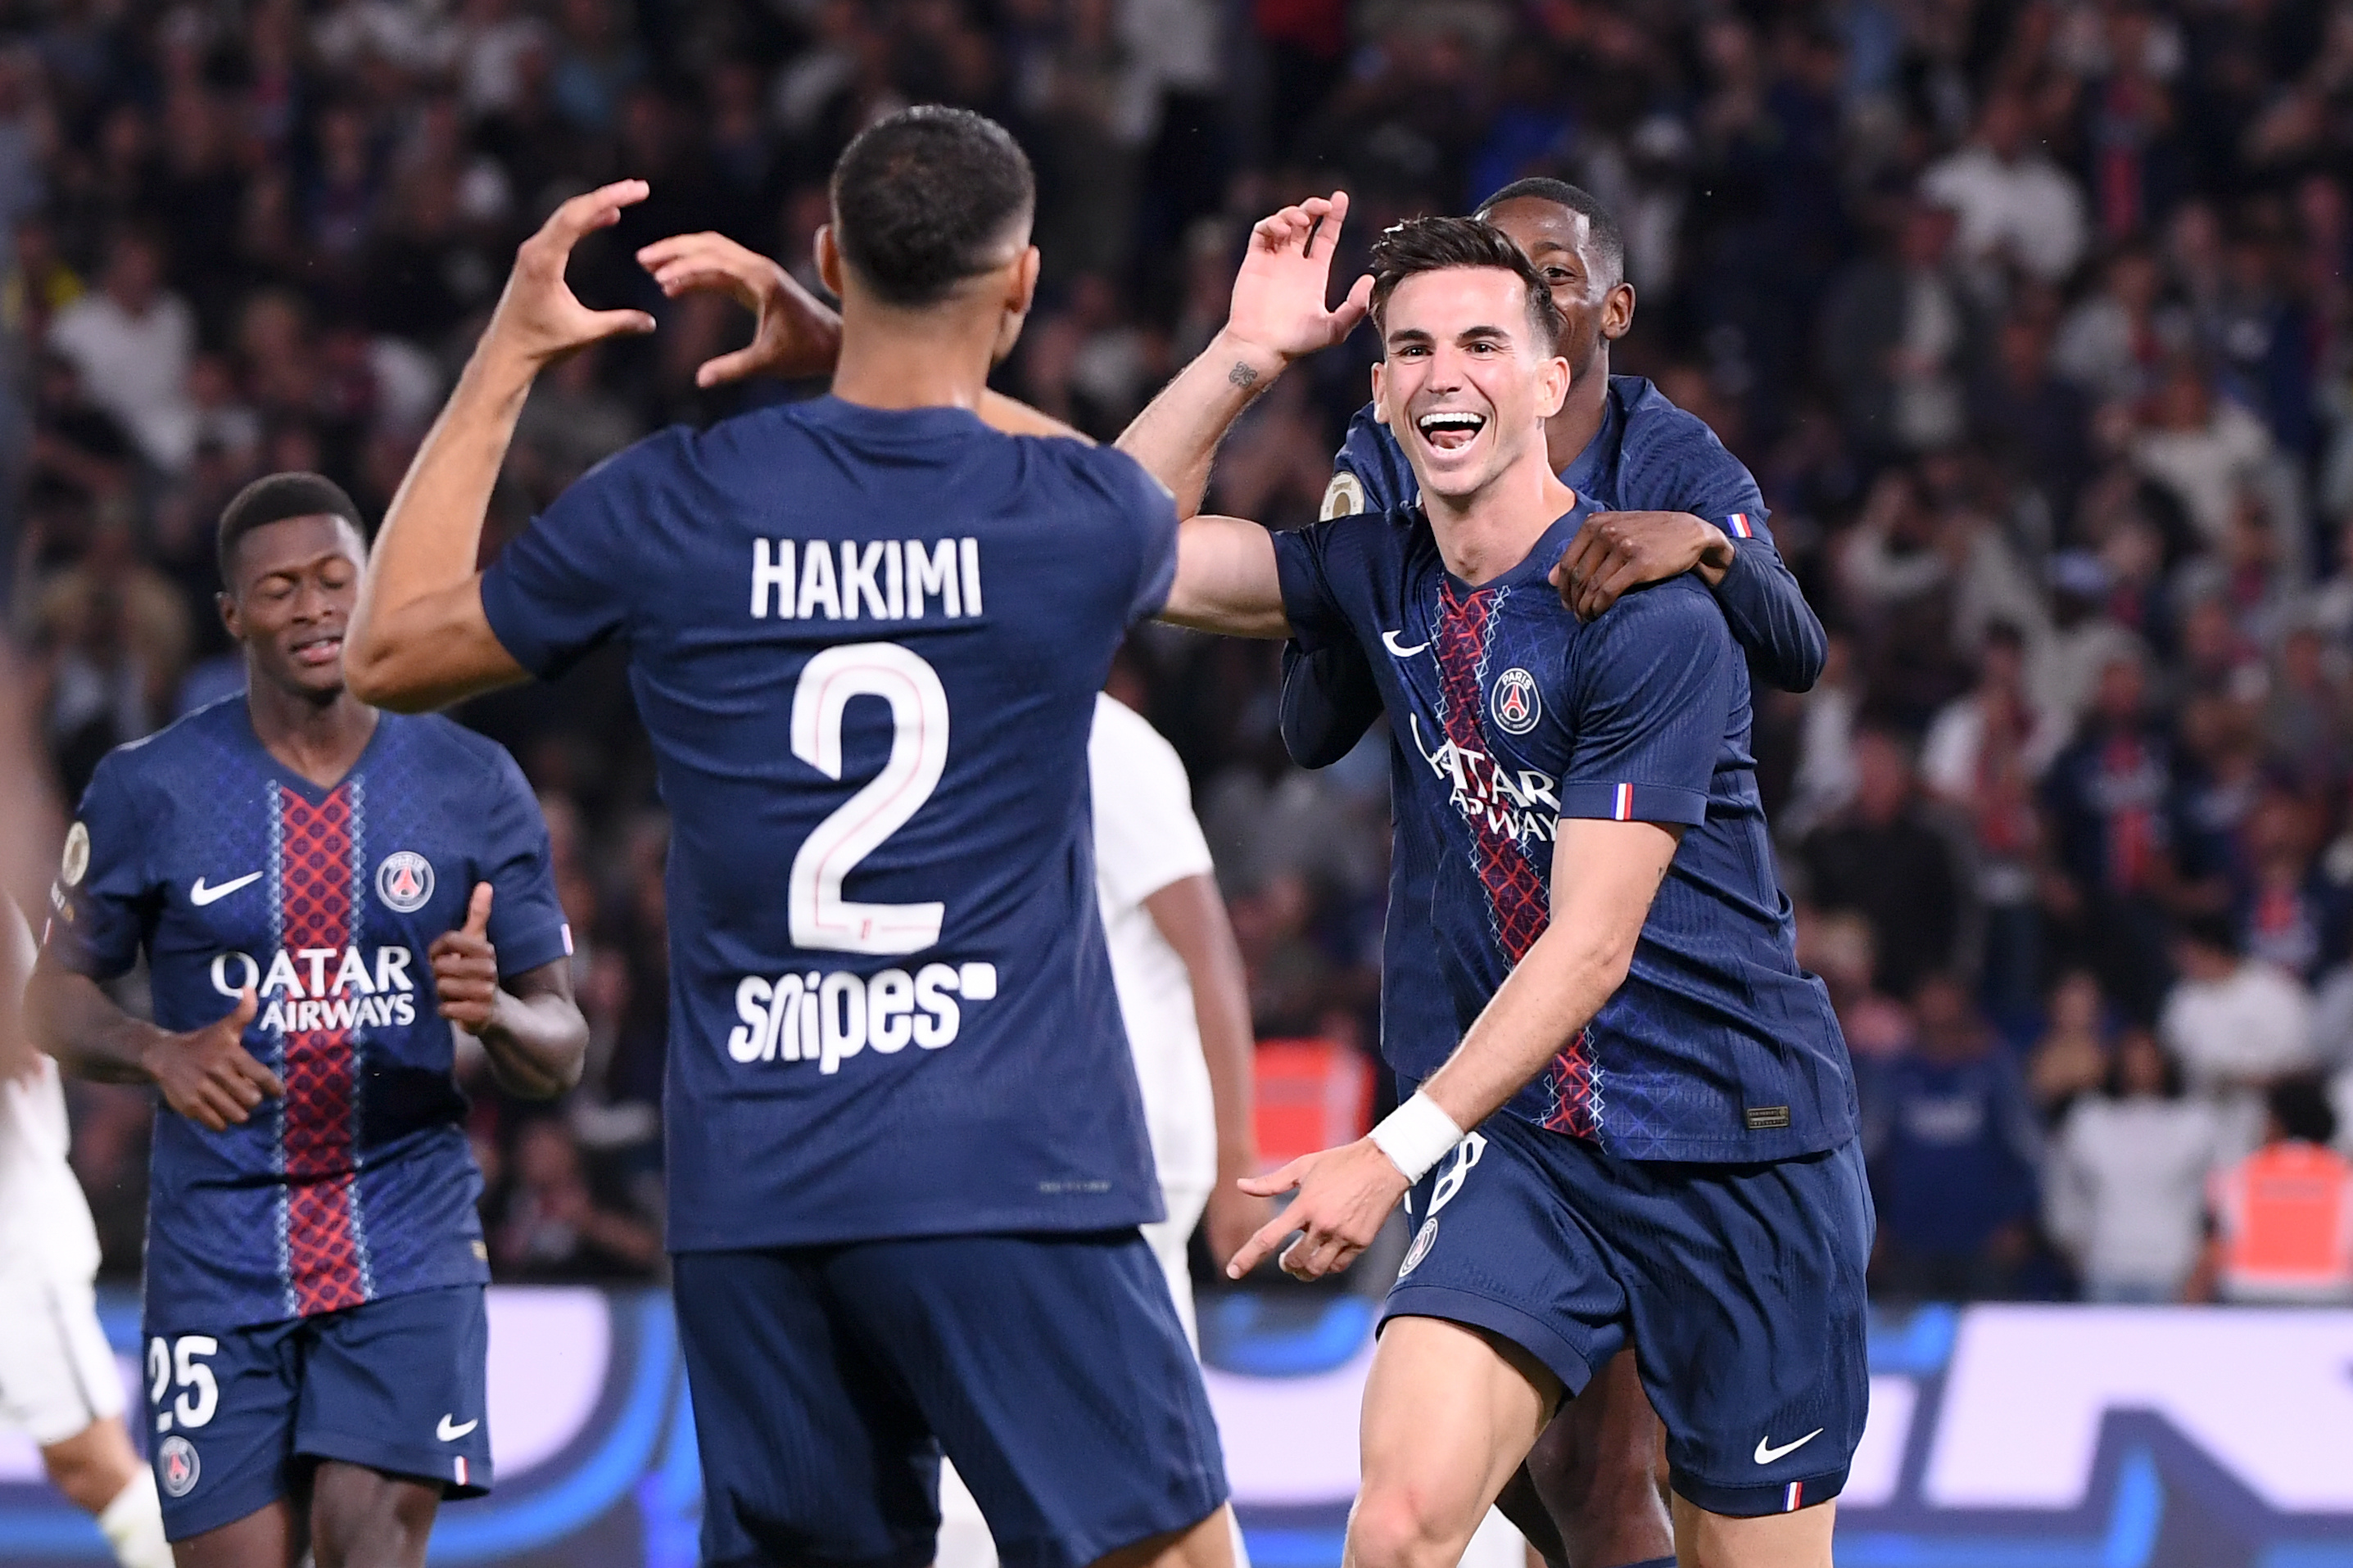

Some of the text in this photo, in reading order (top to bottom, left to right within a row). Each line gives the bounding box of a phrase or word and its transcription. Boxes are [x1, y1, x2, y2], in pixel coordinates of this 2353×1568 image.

[750, 537, 982, 620] HAKIMI
[1501, 671, 1532, 690] PARIS
[788, 641, 950, 956] 2
[1450, 786, 1559, 843] AWAY
[210, 945, 414, 1000] QATAR
[258, 992, 416, 1033] AIRWAYS
[728, 964, 961, 1074] snipes
[147, 1335, 219, 1433] 25
